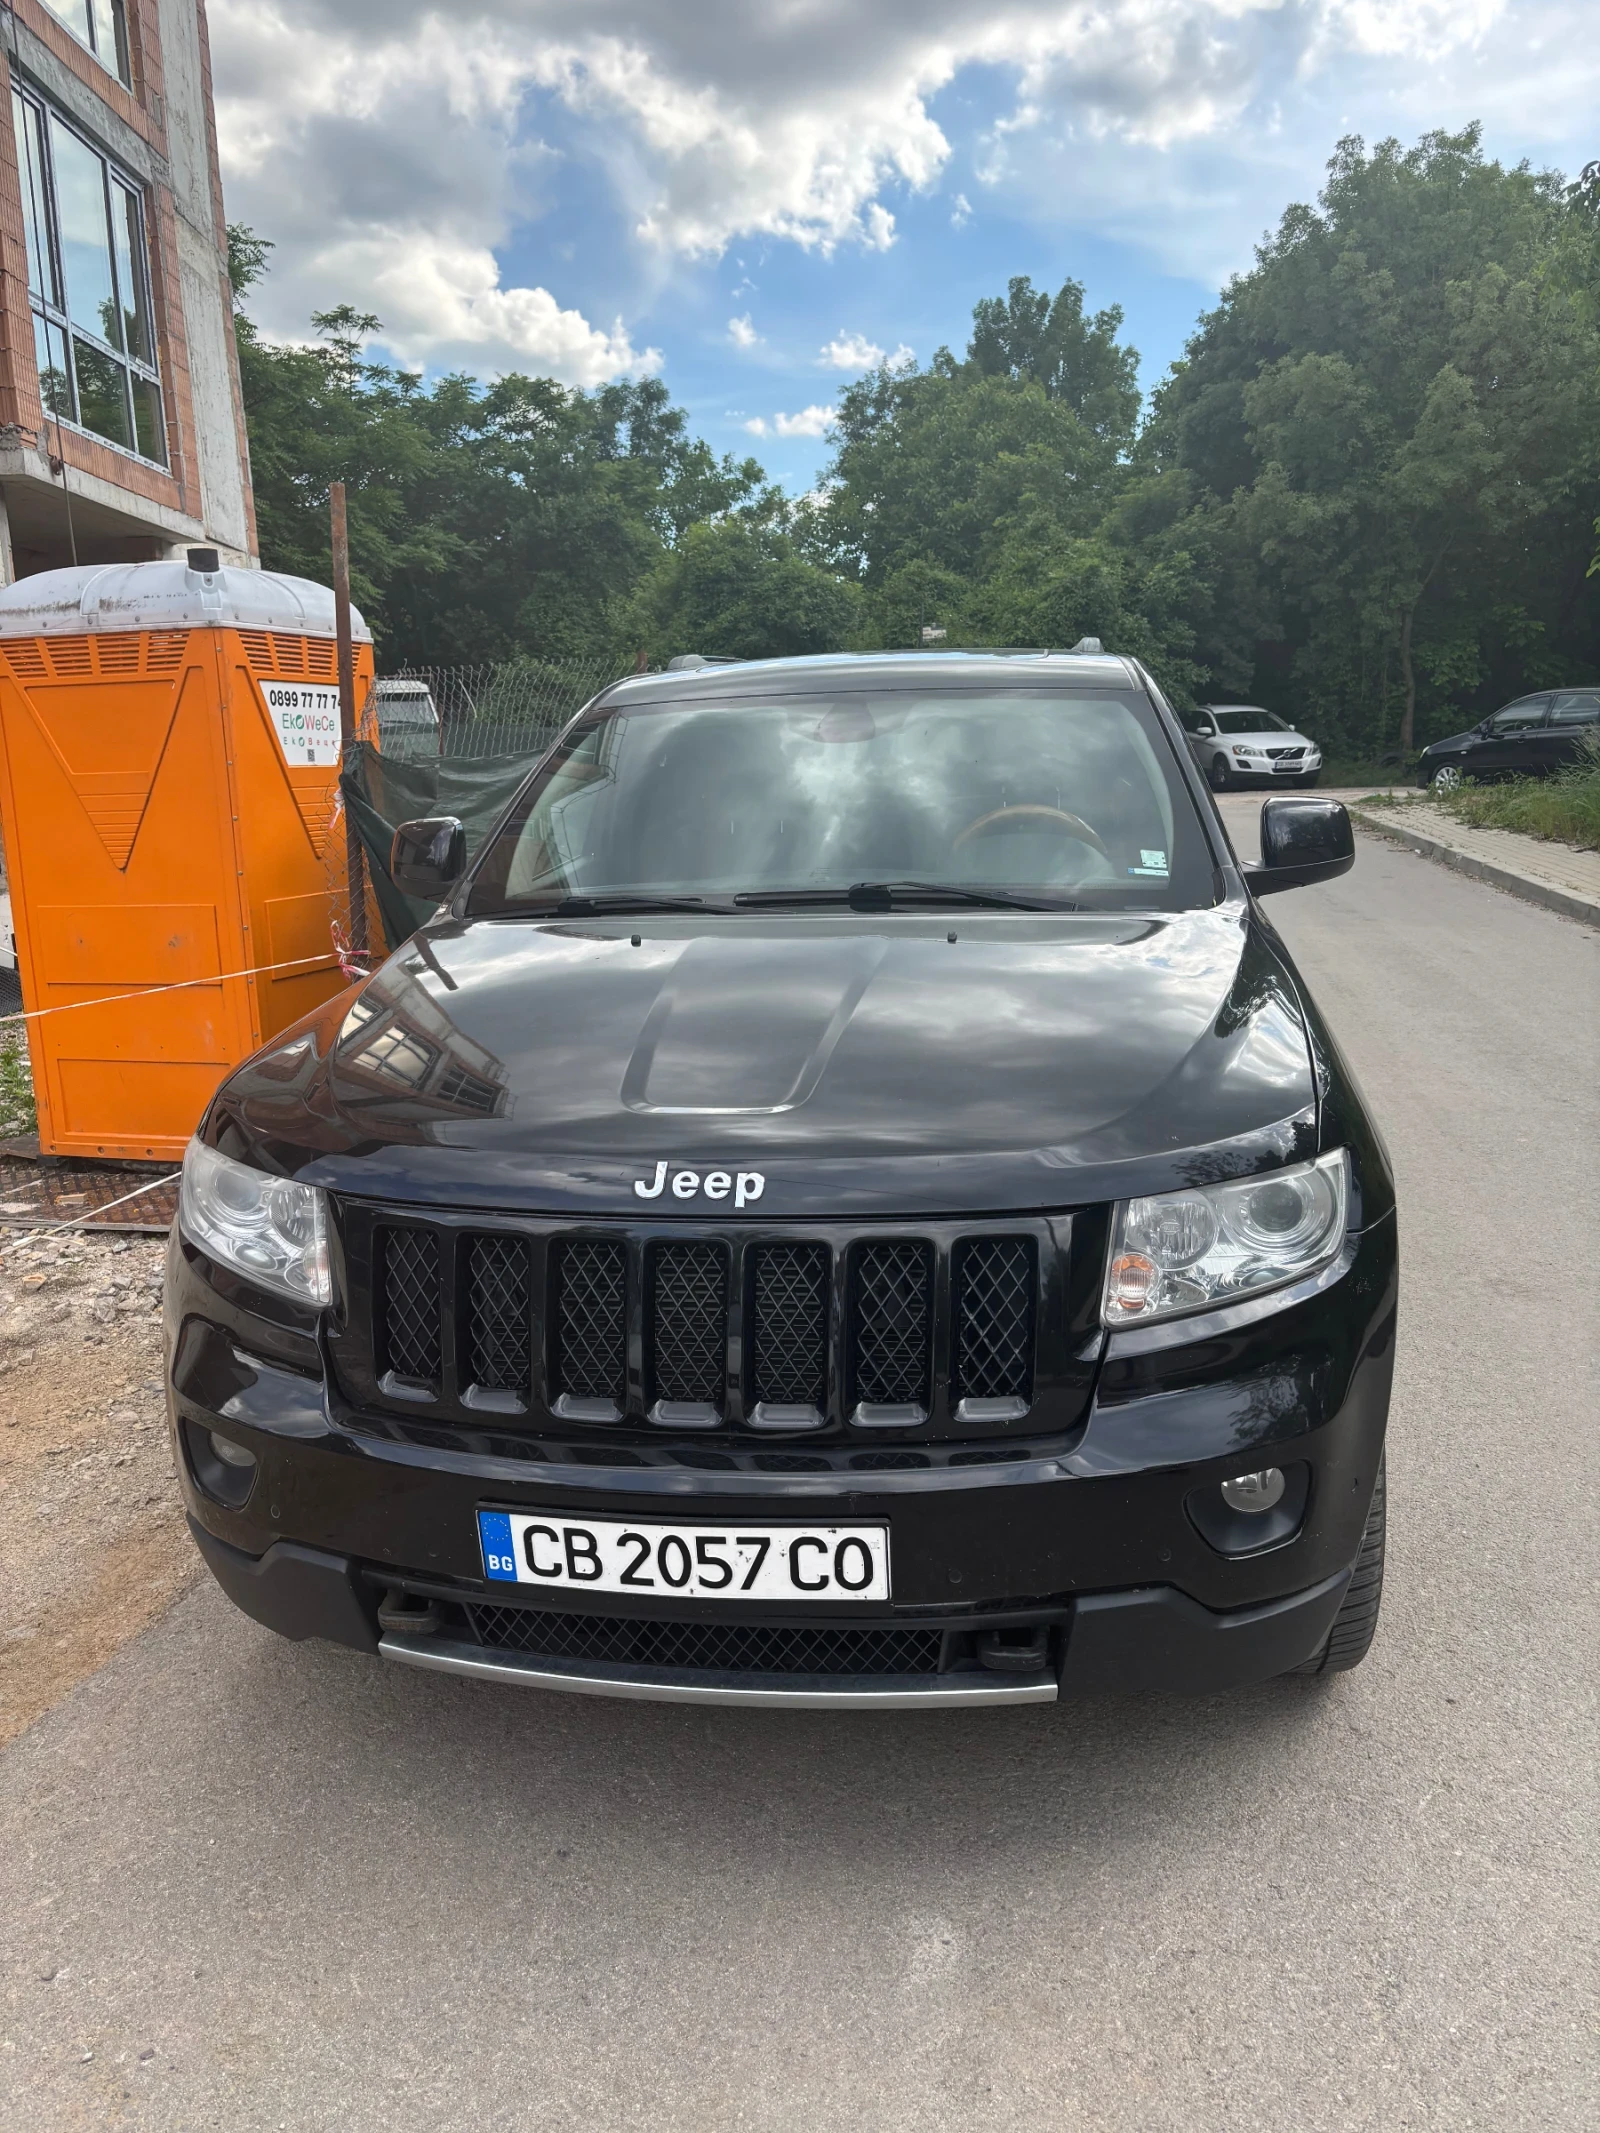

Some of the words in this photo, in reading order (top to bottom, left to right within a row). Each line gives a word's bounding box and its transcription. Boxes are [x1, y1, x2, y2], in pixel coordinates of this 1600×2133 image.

[270, 690, 298, 707] 0899
[301, 692, 313, 708] 77
[316, 693, 328, 709] 77
[634, 1161, 765, 1208] Jeep
[488, 1554, 513, 1571] BG
[523, 1524, 603, 1580] CB
[616, 1532, 771, 1590] 2057
[788, 1536, 874, 1591] CO
